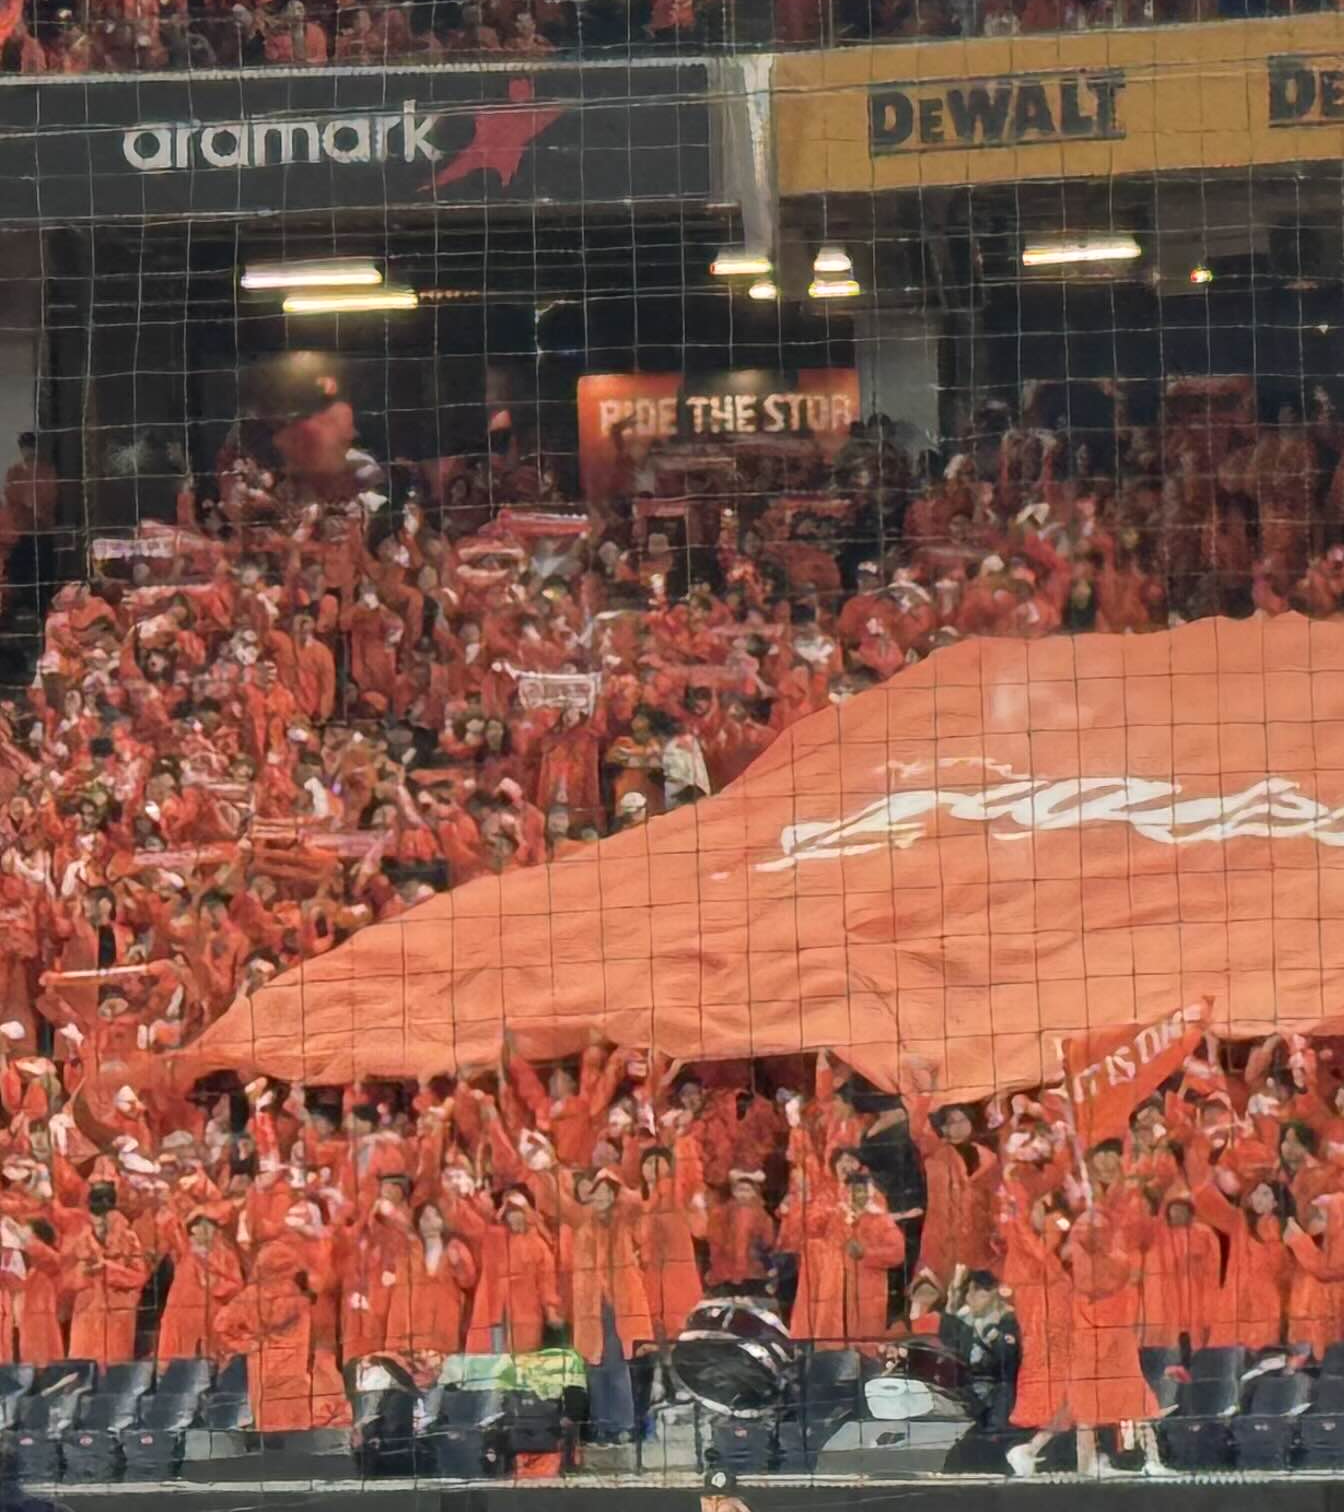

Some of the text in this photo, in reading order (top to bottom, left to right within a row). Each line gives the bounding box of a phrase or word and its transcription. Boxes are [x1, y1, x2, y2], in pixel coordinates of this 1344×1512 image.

[123, 100, 441, 171] aramark
[686, 394, 757, 433] THE
[763, 393, 852, 433] STOR
